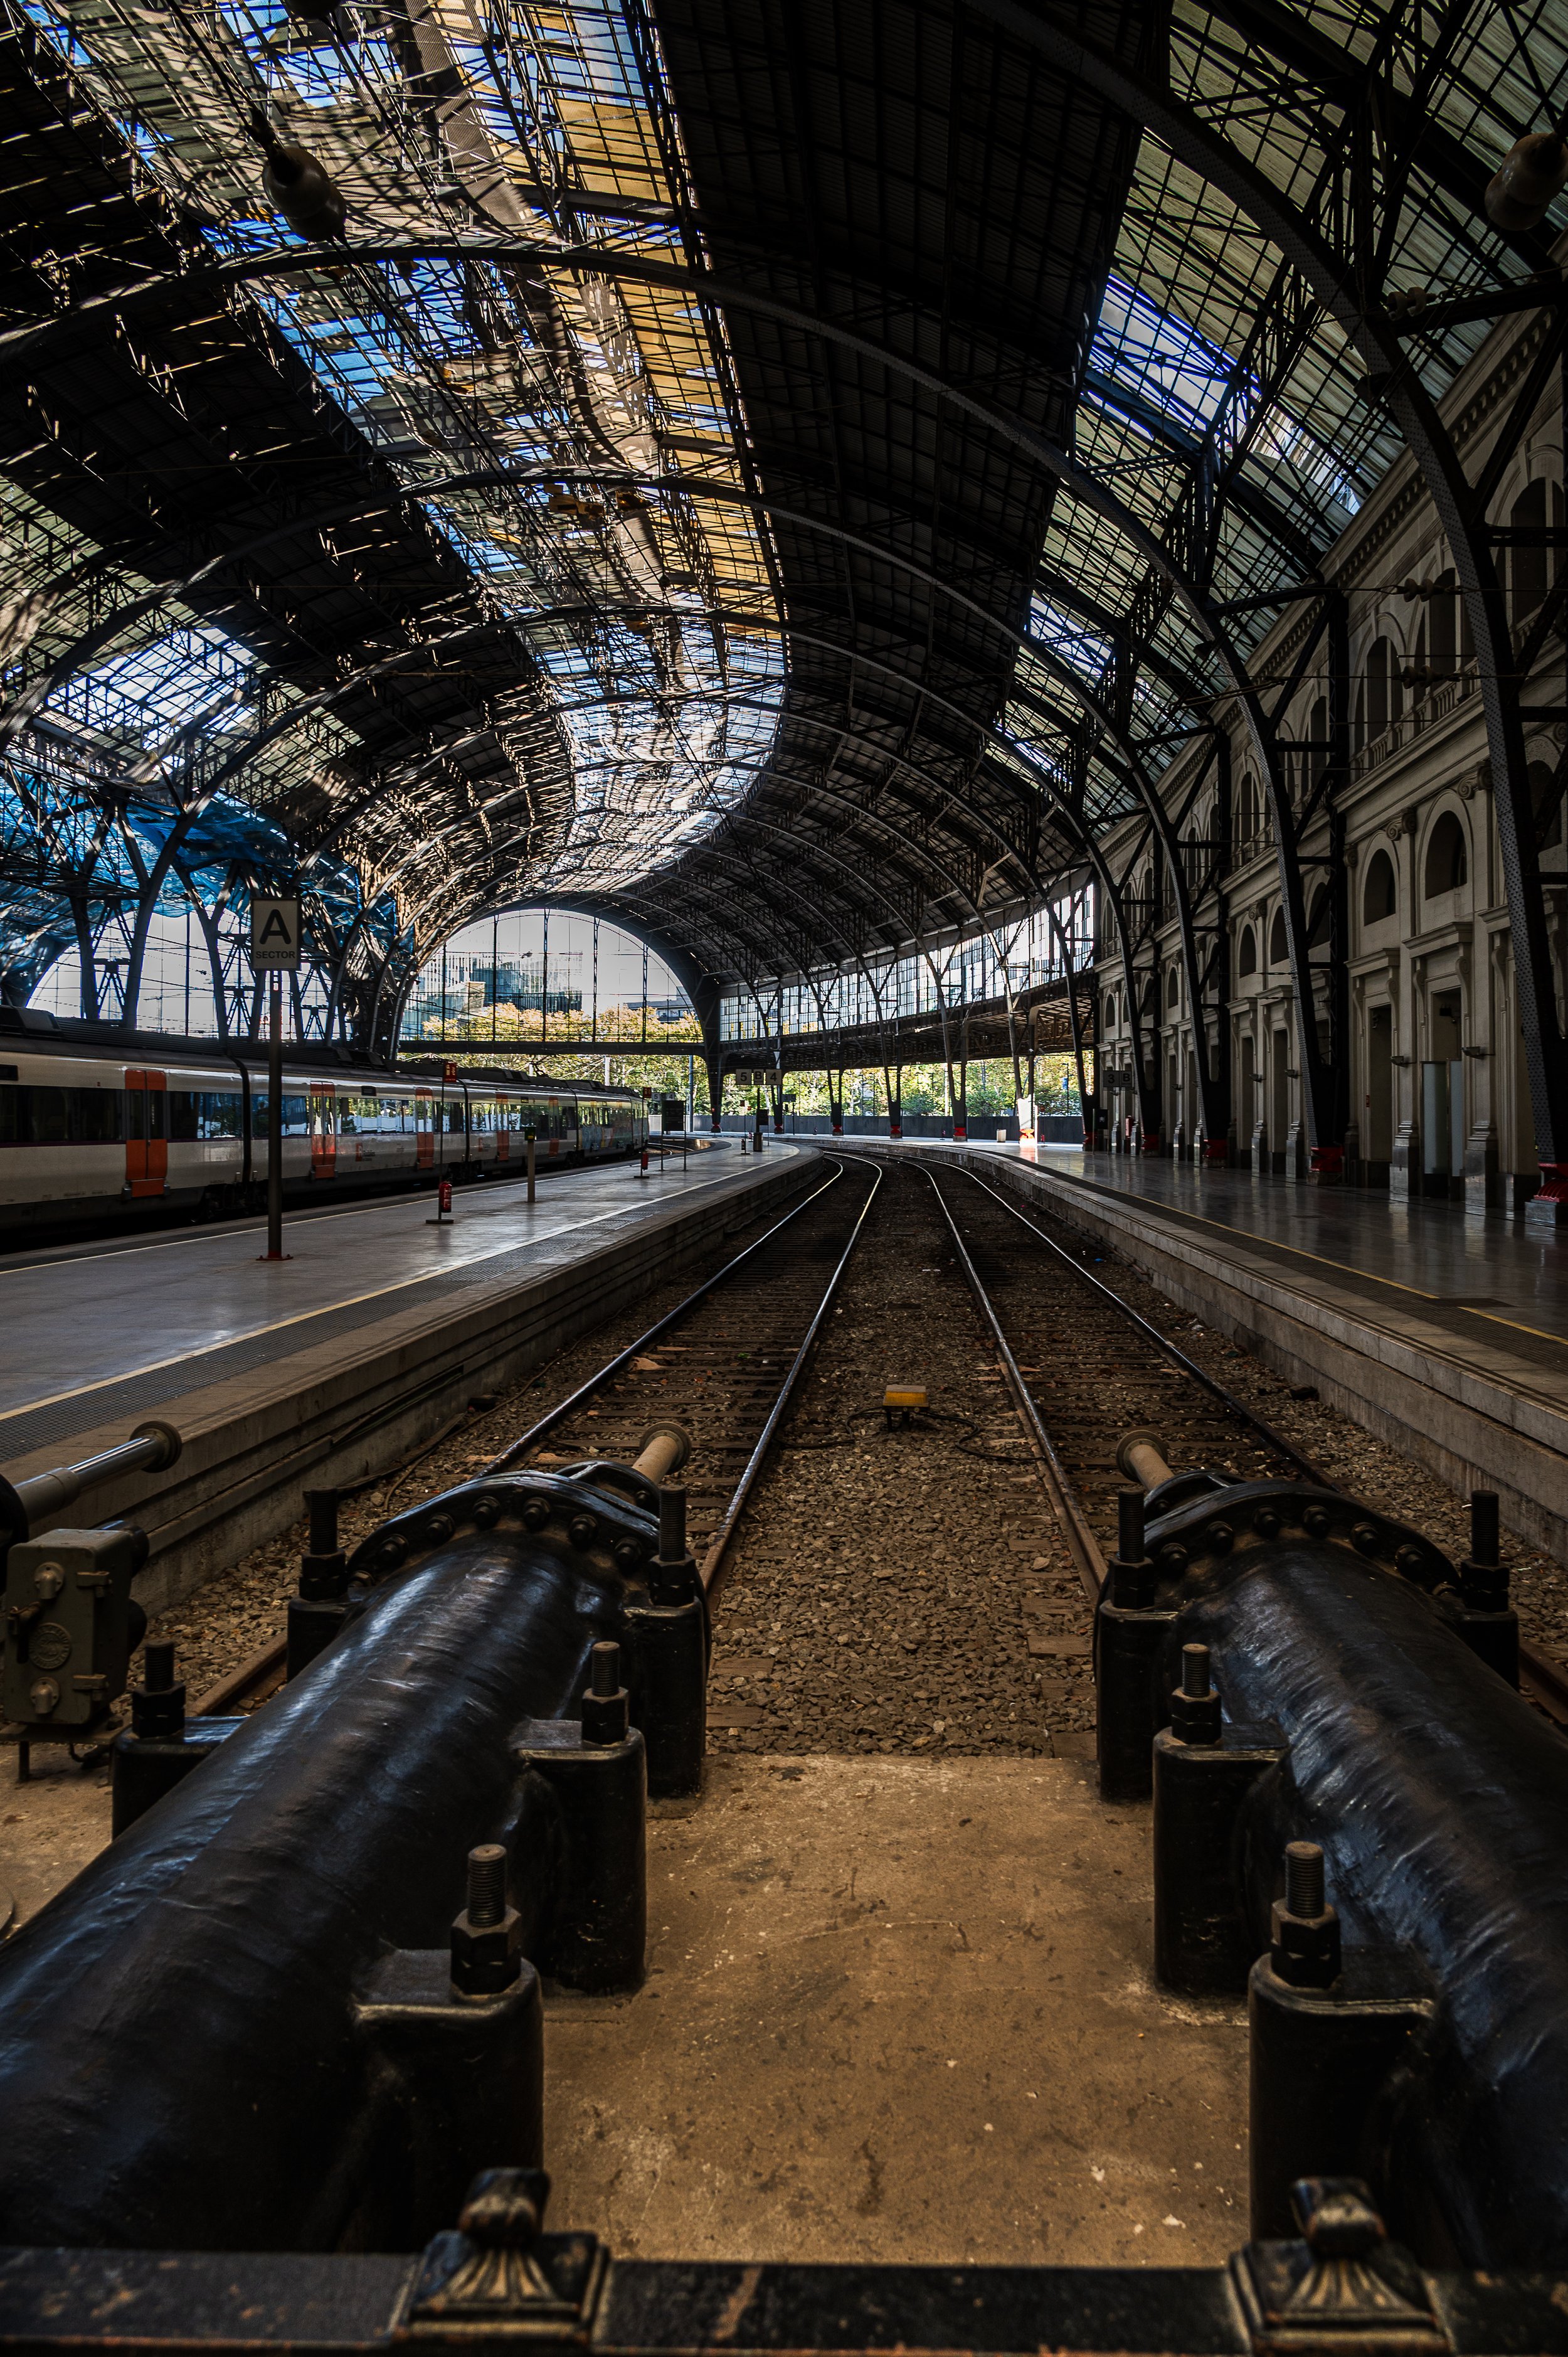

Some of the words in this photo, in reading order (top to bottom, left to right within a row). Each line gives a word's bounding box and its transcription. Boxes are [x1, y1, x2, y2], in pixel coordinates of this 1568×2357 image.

[259, 908, 292, 945] A
[255, 950, 295, 959] SECTOR
[740, 1072, 747, 1082] 5
[755, 1071, 762, 1080] B
[770, 1072, 777, 1082] 4
[1108, 1074, 1115, 1083] 3
[1123, 1073, 1130, 1082] B
